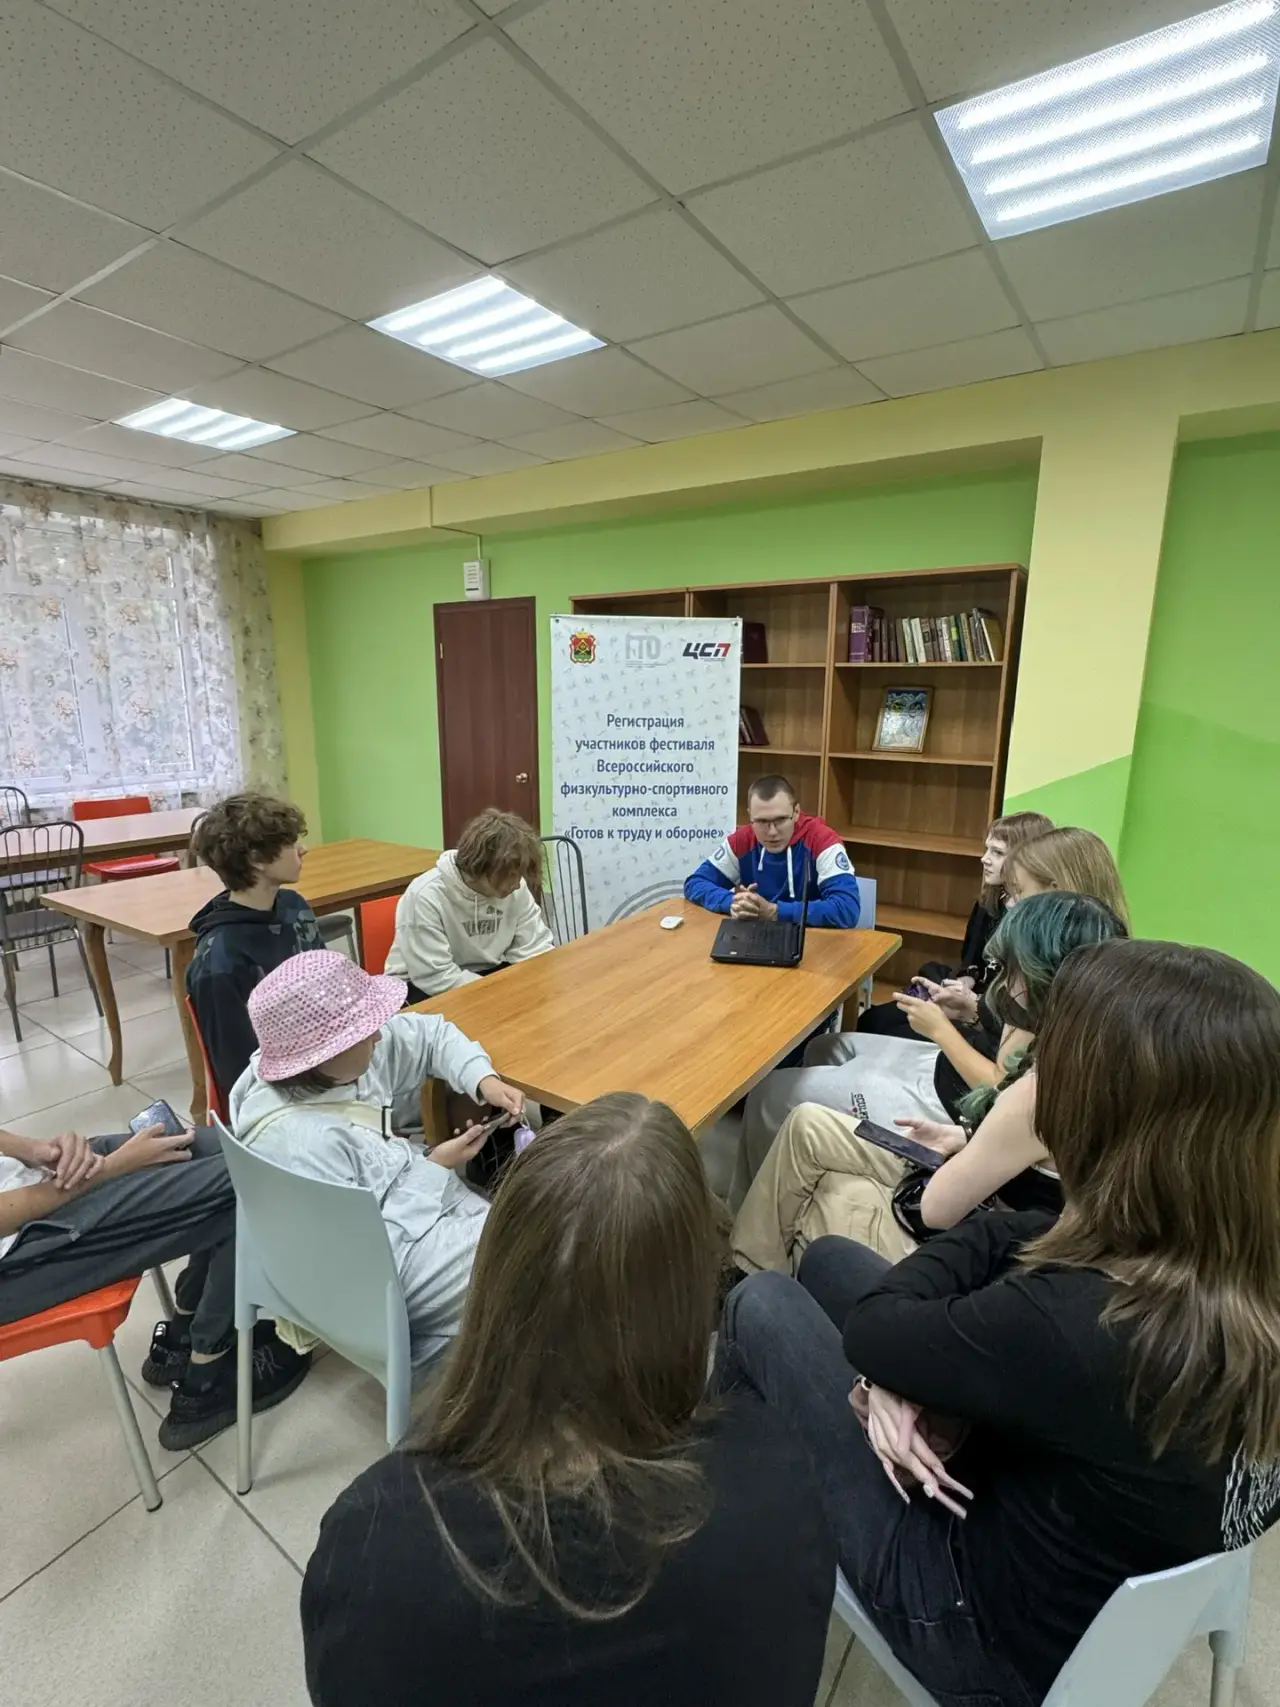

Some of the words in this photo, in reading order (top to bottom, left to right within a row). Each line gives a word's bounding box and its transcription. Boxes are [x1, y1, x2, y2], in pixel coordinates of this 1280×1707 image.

[682, 642, 732, 660] ЦСП
[606, 713, 684, 731] Регистрация
[575, 738, 646, 752] участников
[649, 737, 715, 752] фестиваля
[596, 759, 694, 775] Всероссийского
[560, 782, 729, 798] физкультурно-спортивного
[612, 805, 678, 817] комплекса
[564, 826, 604, 840] «Готов
[607, 828, 614, 839] к
[618, 828, 652, 843] труду
[655, 828, 662, 839] и
[666, 825, 725, 843] обороне»
